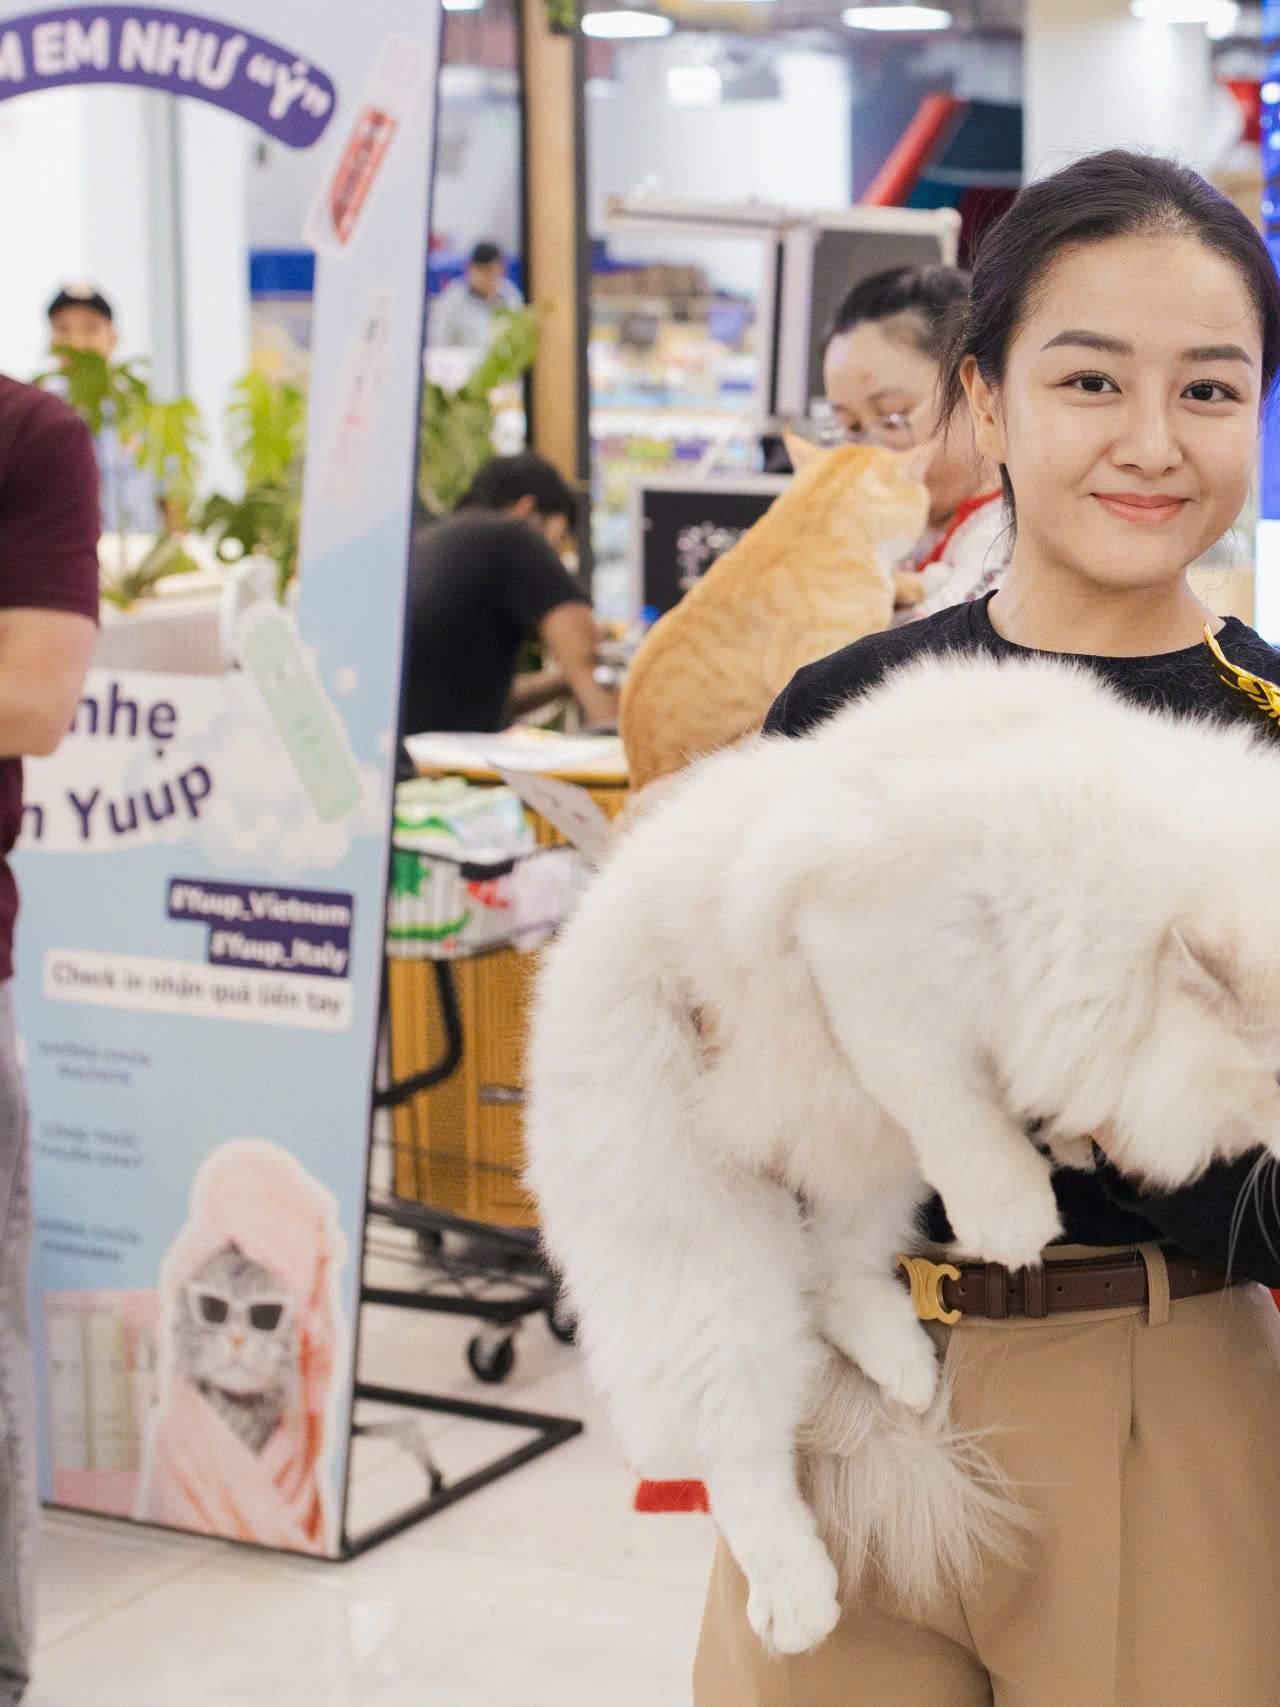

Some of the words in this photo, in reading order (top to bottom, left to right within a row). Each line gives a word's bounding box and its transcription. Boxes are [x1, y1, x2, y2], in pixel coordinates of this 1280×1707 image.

[32, 17, 110, 76] EM
[119, 17, 248, 91] NHƯ
[67, 763, 213, 840] Yuup
[51, 959, 115, 989] Check
